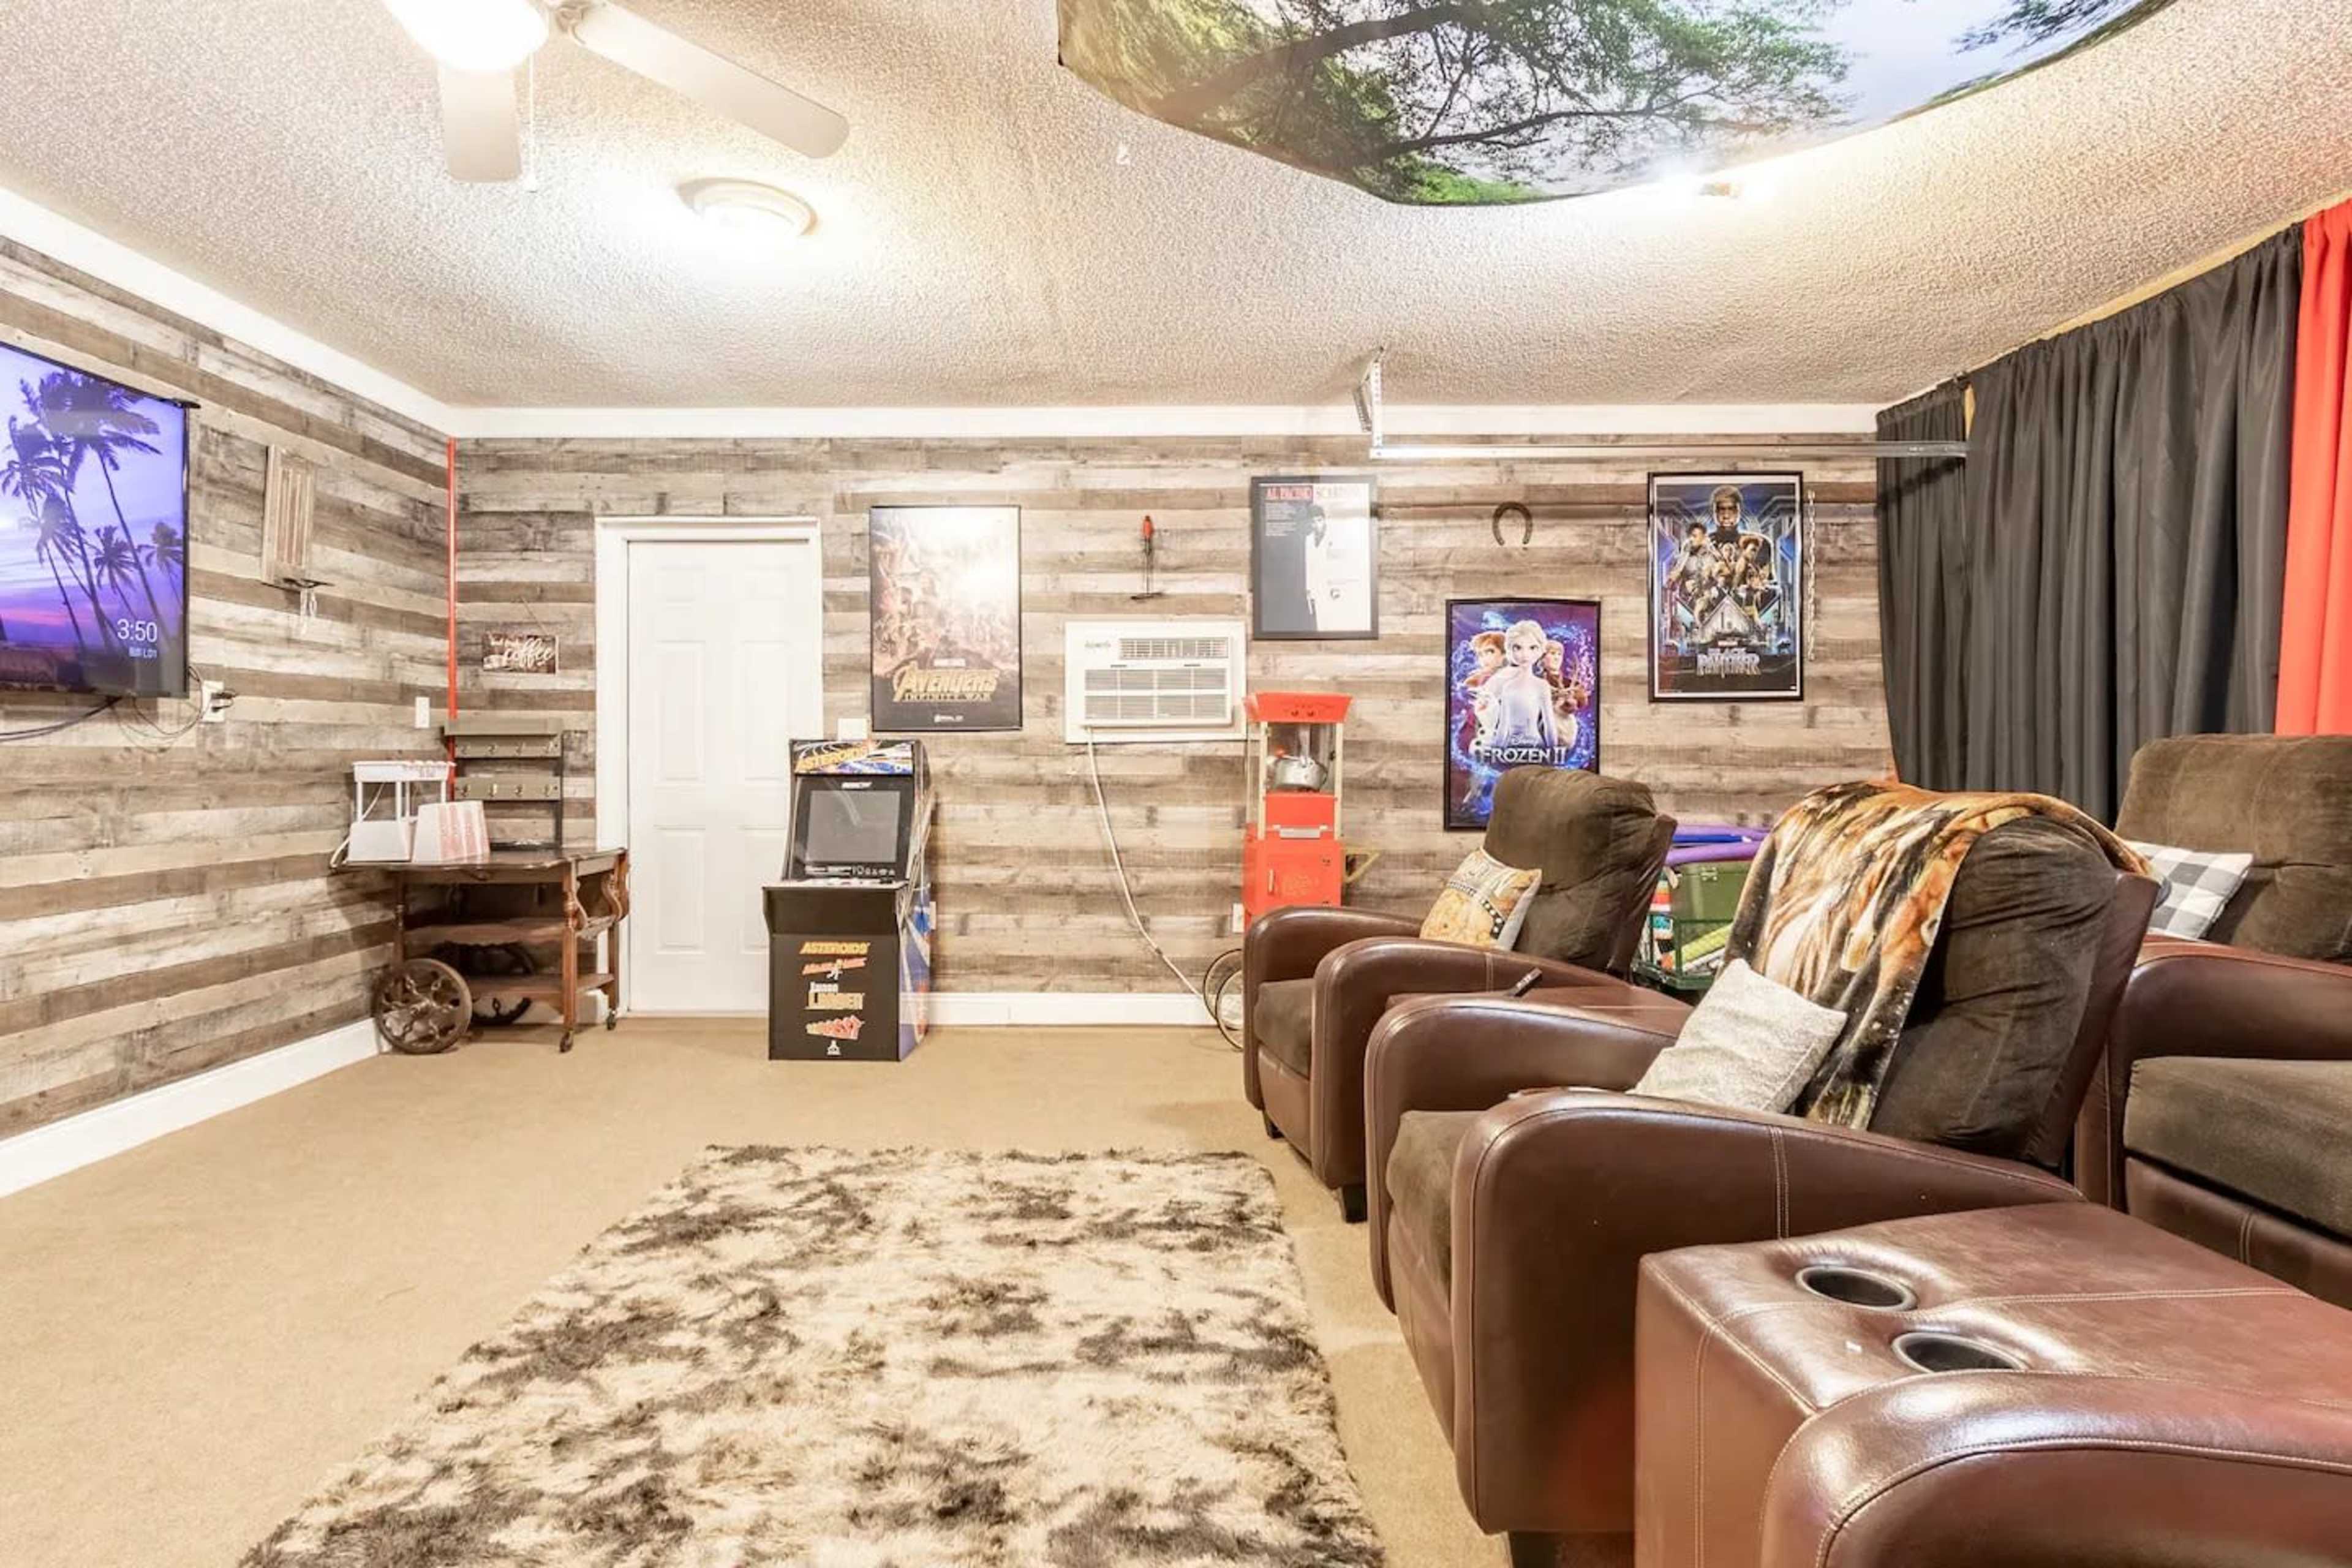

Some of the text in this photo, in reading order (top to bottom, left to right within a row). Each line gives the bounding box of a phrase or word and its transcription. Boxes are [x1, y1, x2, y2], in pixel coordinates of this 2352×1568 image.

[117, 618, 157, 643] 3:50
[1483, 746, 1567, 765] FROZEN II
